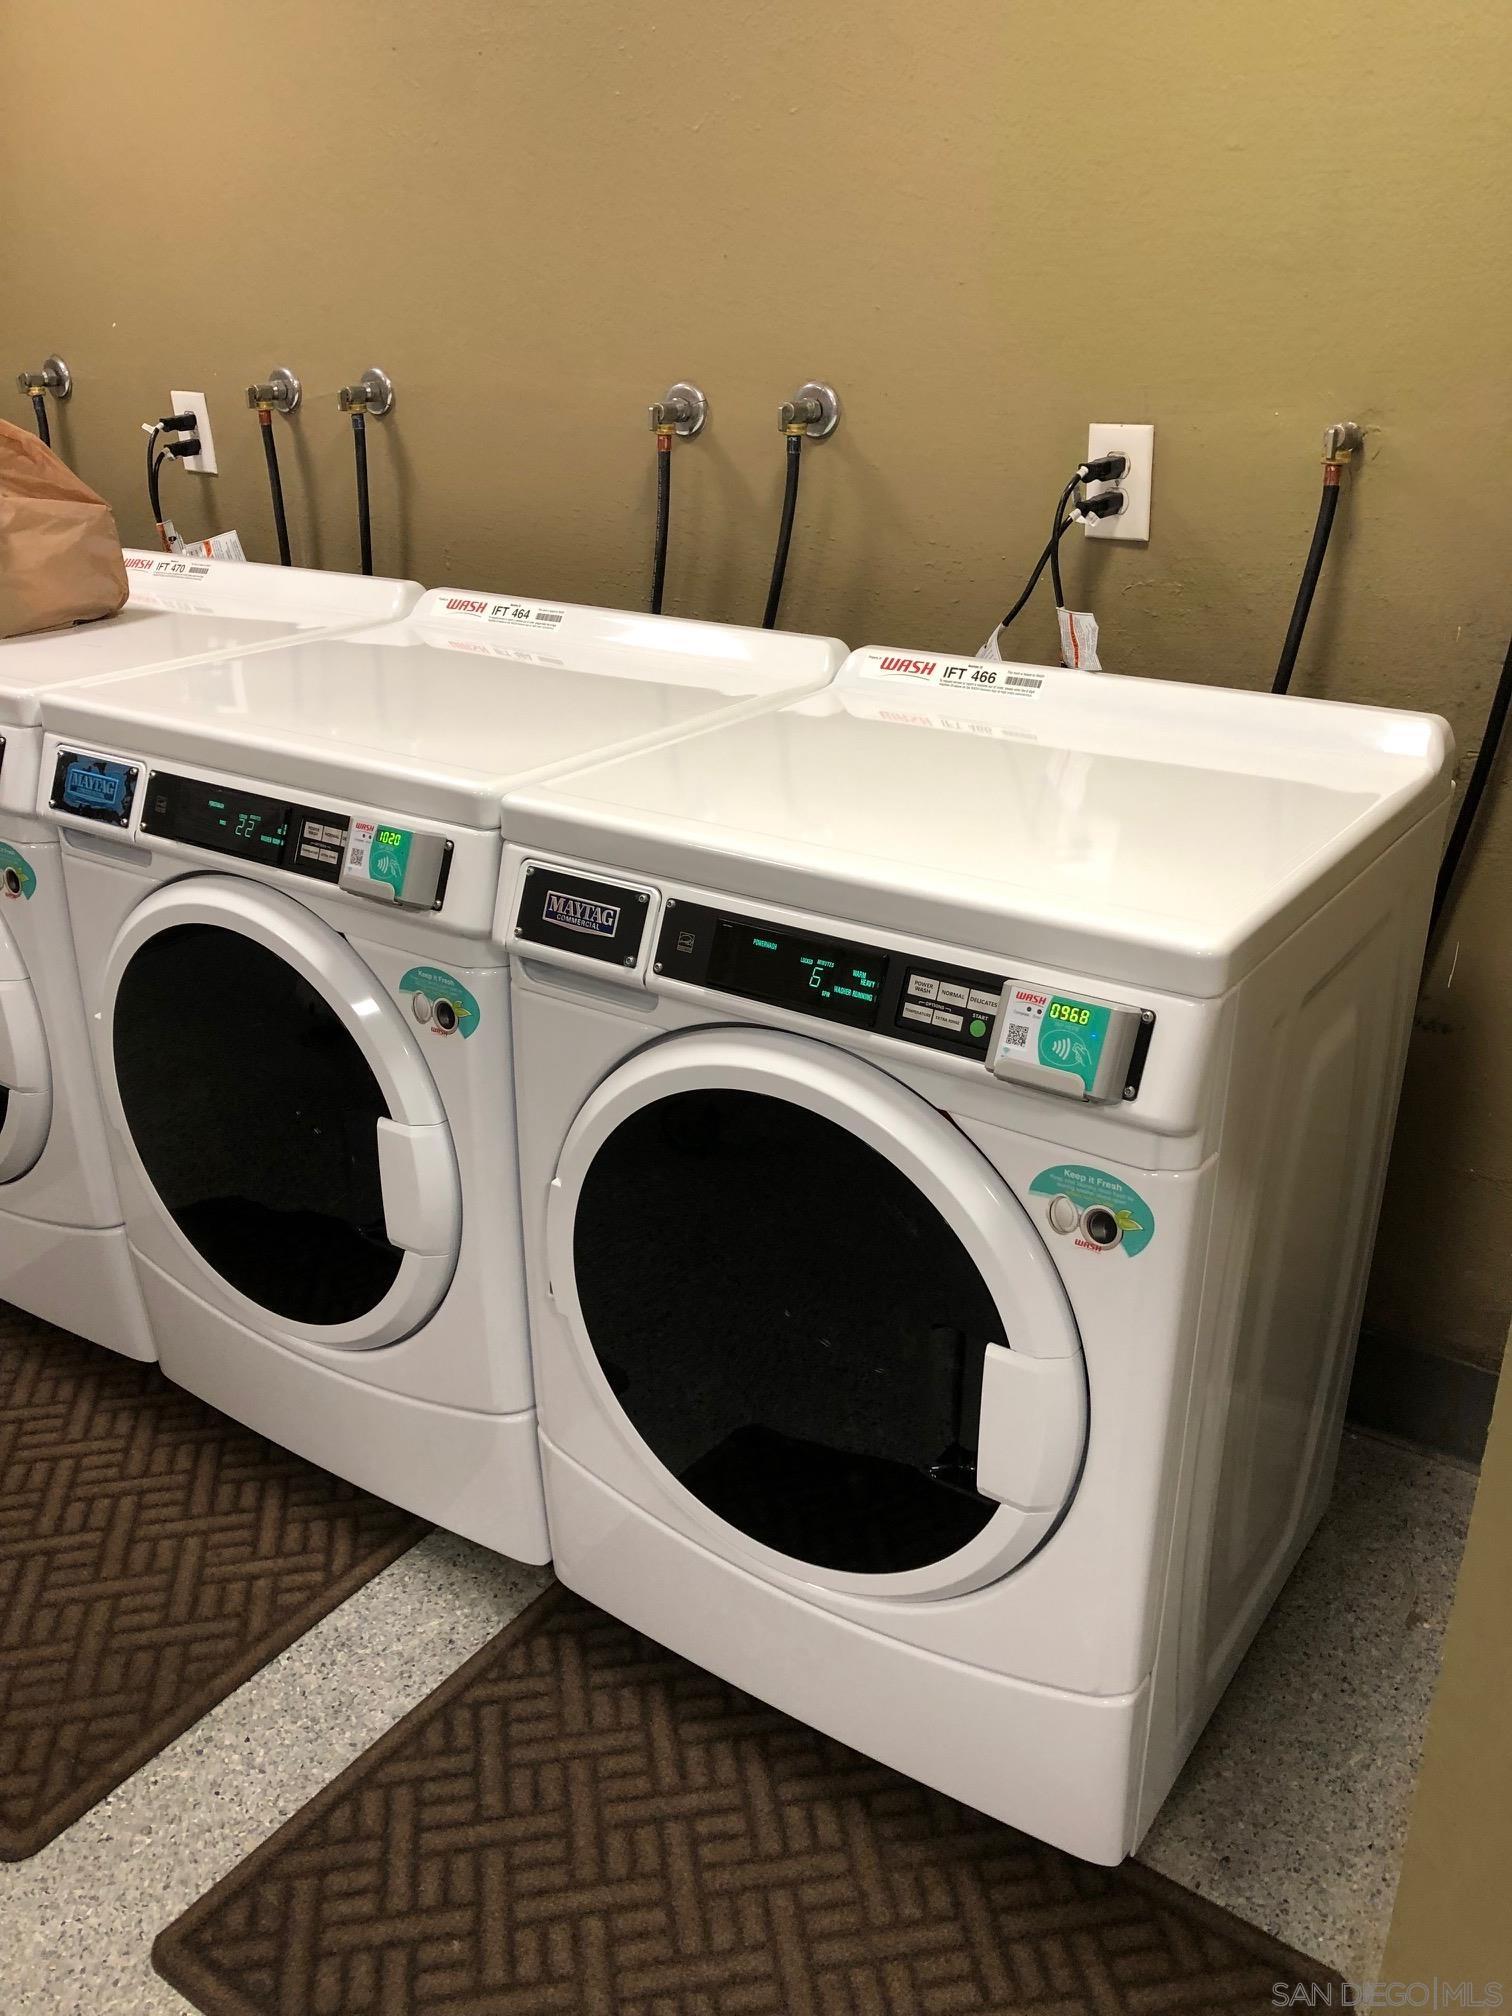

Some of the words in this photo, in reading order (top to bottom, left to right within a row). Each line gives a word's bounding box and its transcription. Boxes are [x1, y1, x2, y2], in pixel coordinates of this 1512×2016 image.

[124, 558, 154, 570] WASH
[156, 562, 170, 571] IFT
[171, 564, 185, 573] 470
[446, 598, 488, 614] WASH
[491, 605, 510, 617] IFT
[511, 608, 531, 620] 464
[880, 656, 937, 676] WASH
[943, 666, 968, 680] IFT
[971, 670, 997, 684] 466
[69, 772, 115, 794] MAYTAG
[235, 818, 255, 838] 22
[355, 822, 375, 832] WASH
[379, 831, 401, 846] 1020
[548, 895, 614, 927] MAYTAG
[556, 913, 600, 931] COMMERCIAL
[808, 966, 824, 988] 6
[914, 980, 934, 990] POWER
[914, 985, 931, 995] WASH
[941, 989, 965, 1000] NORMAL
[970, 996, 998, 1008] DELICATES
[1015, 991, 1047, 1005] WASH
[972, 1013, 989, 1021] START
[1049, 1003, 1090, 1025] 0968
[1063, 1169, 1087, 1182] Keep
[1088, 1175, 1095, 1183] it
[1096, 1177, 1123, 1192] Fresh
[1074, 1238, 1102, 1252] WASH
